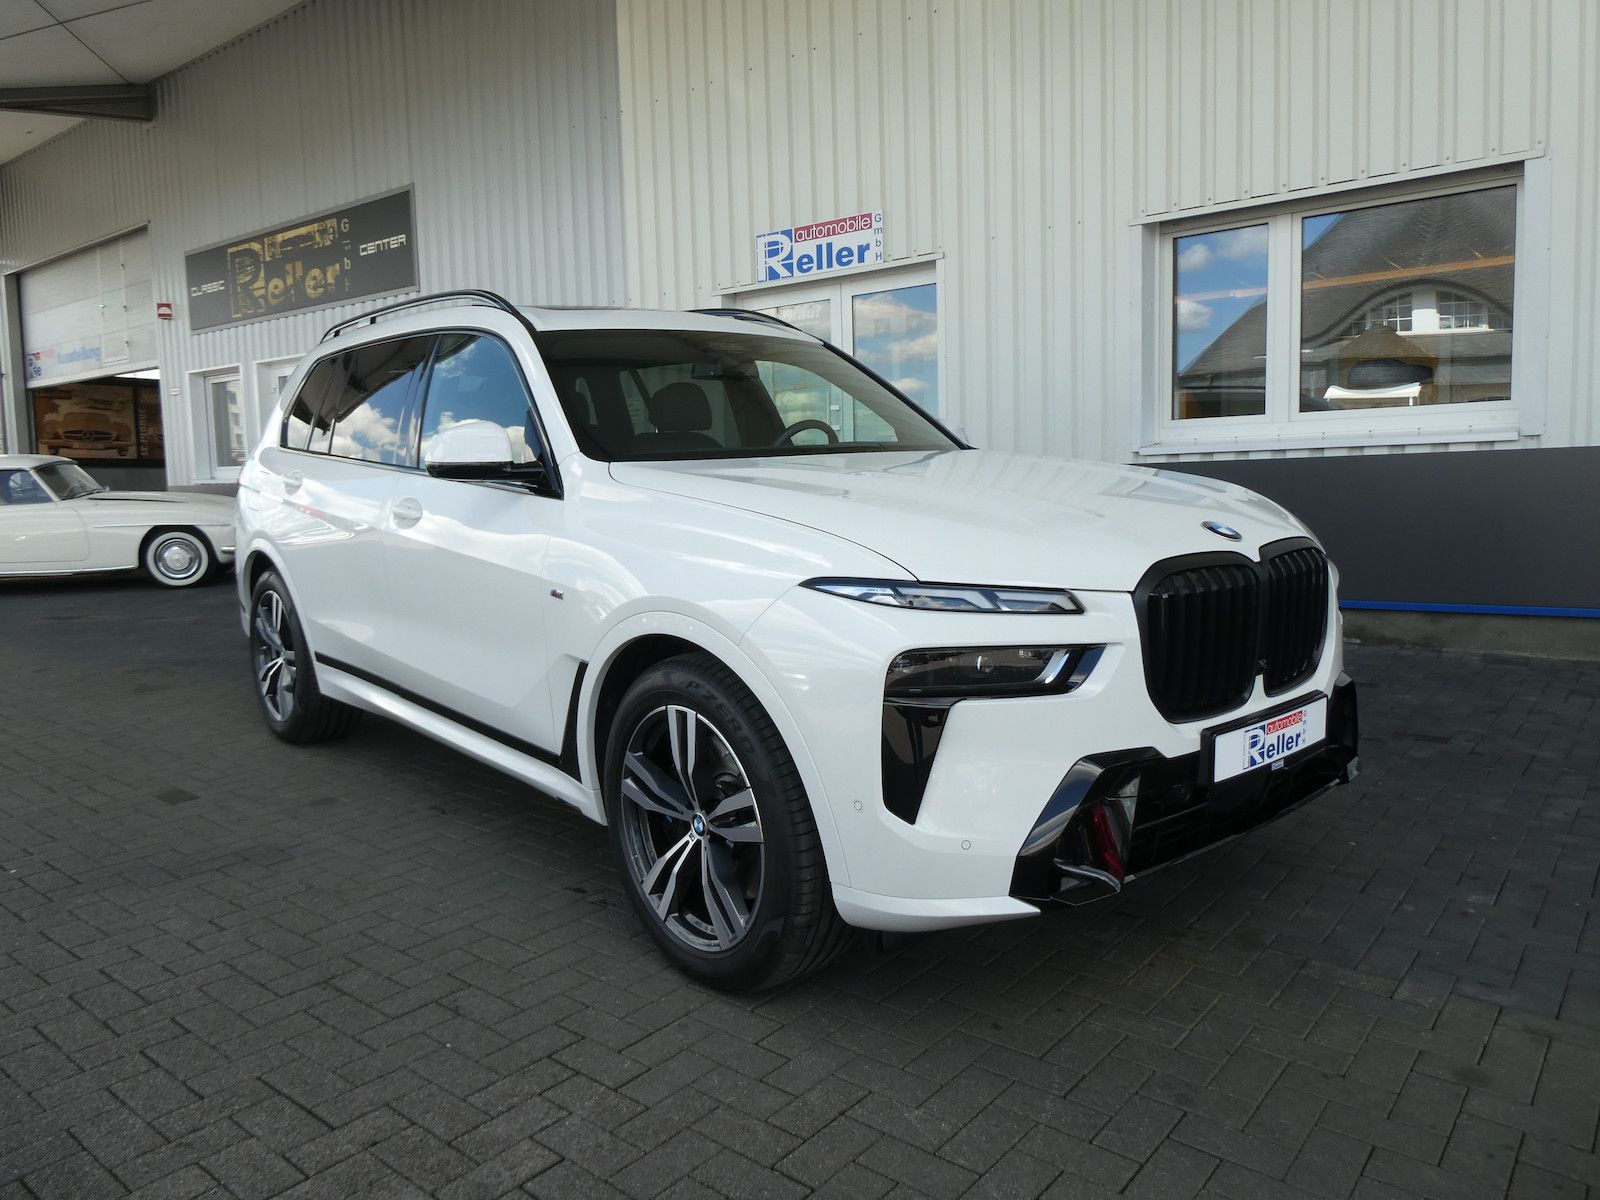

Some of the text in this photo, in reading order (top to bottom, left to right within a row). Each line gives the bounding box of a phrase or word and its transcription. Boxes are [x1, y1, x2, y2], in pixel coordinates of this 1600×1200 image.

[359, 234, 408, 256] CENTER
[796, 216, 871, 243] automobile
[873, 213, 883, 262] GmbH
[756, 229, 871, 283] Reller
[1267, 711, 1303, 734] automobile
[1243, 724, 1302, 770] Reller
